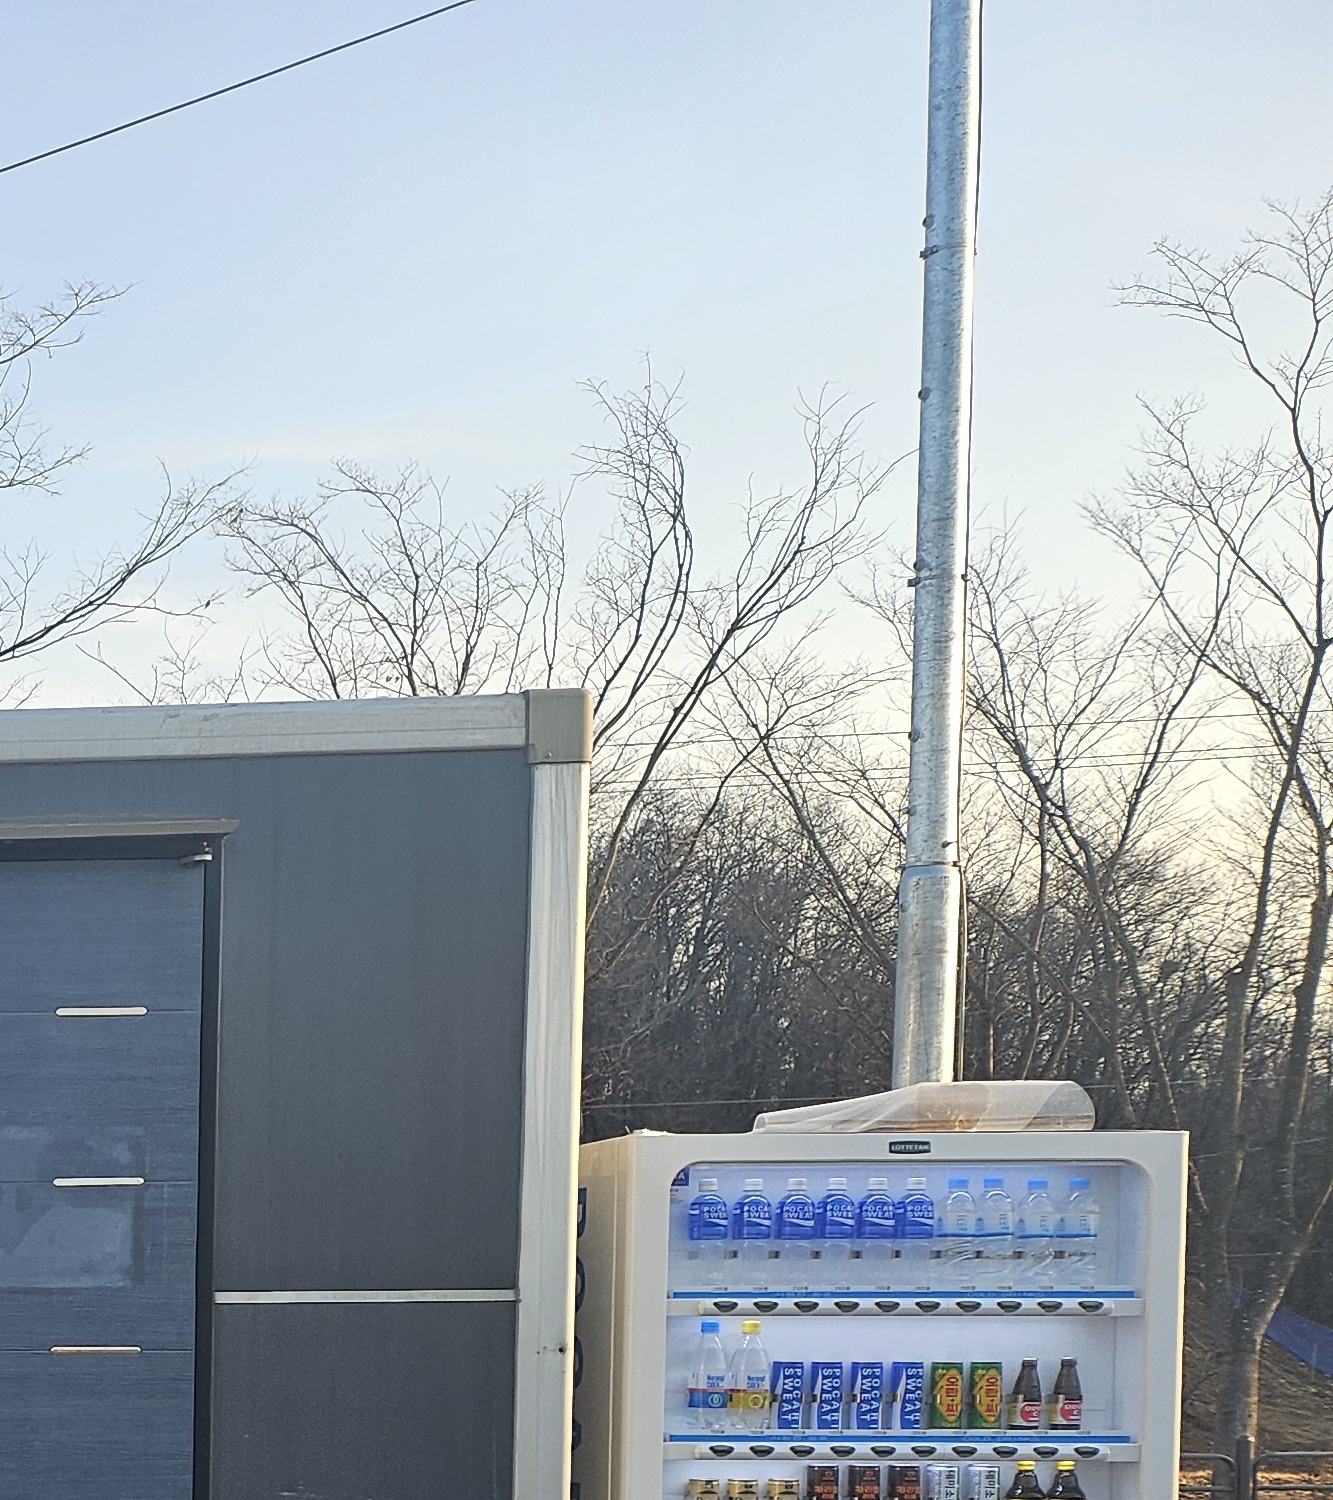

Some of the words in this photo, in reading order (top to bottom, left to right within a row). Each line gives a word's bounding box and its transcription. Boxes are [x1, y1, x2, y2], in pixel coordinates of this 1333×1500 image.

[782, 1368, 793, 1420] SWEAT
[821, 1368, 833, 1420] SWEAT
[860, 1368, 872, 1420] SWEAT
[904, 1368, 916, 1420] SWEAT
